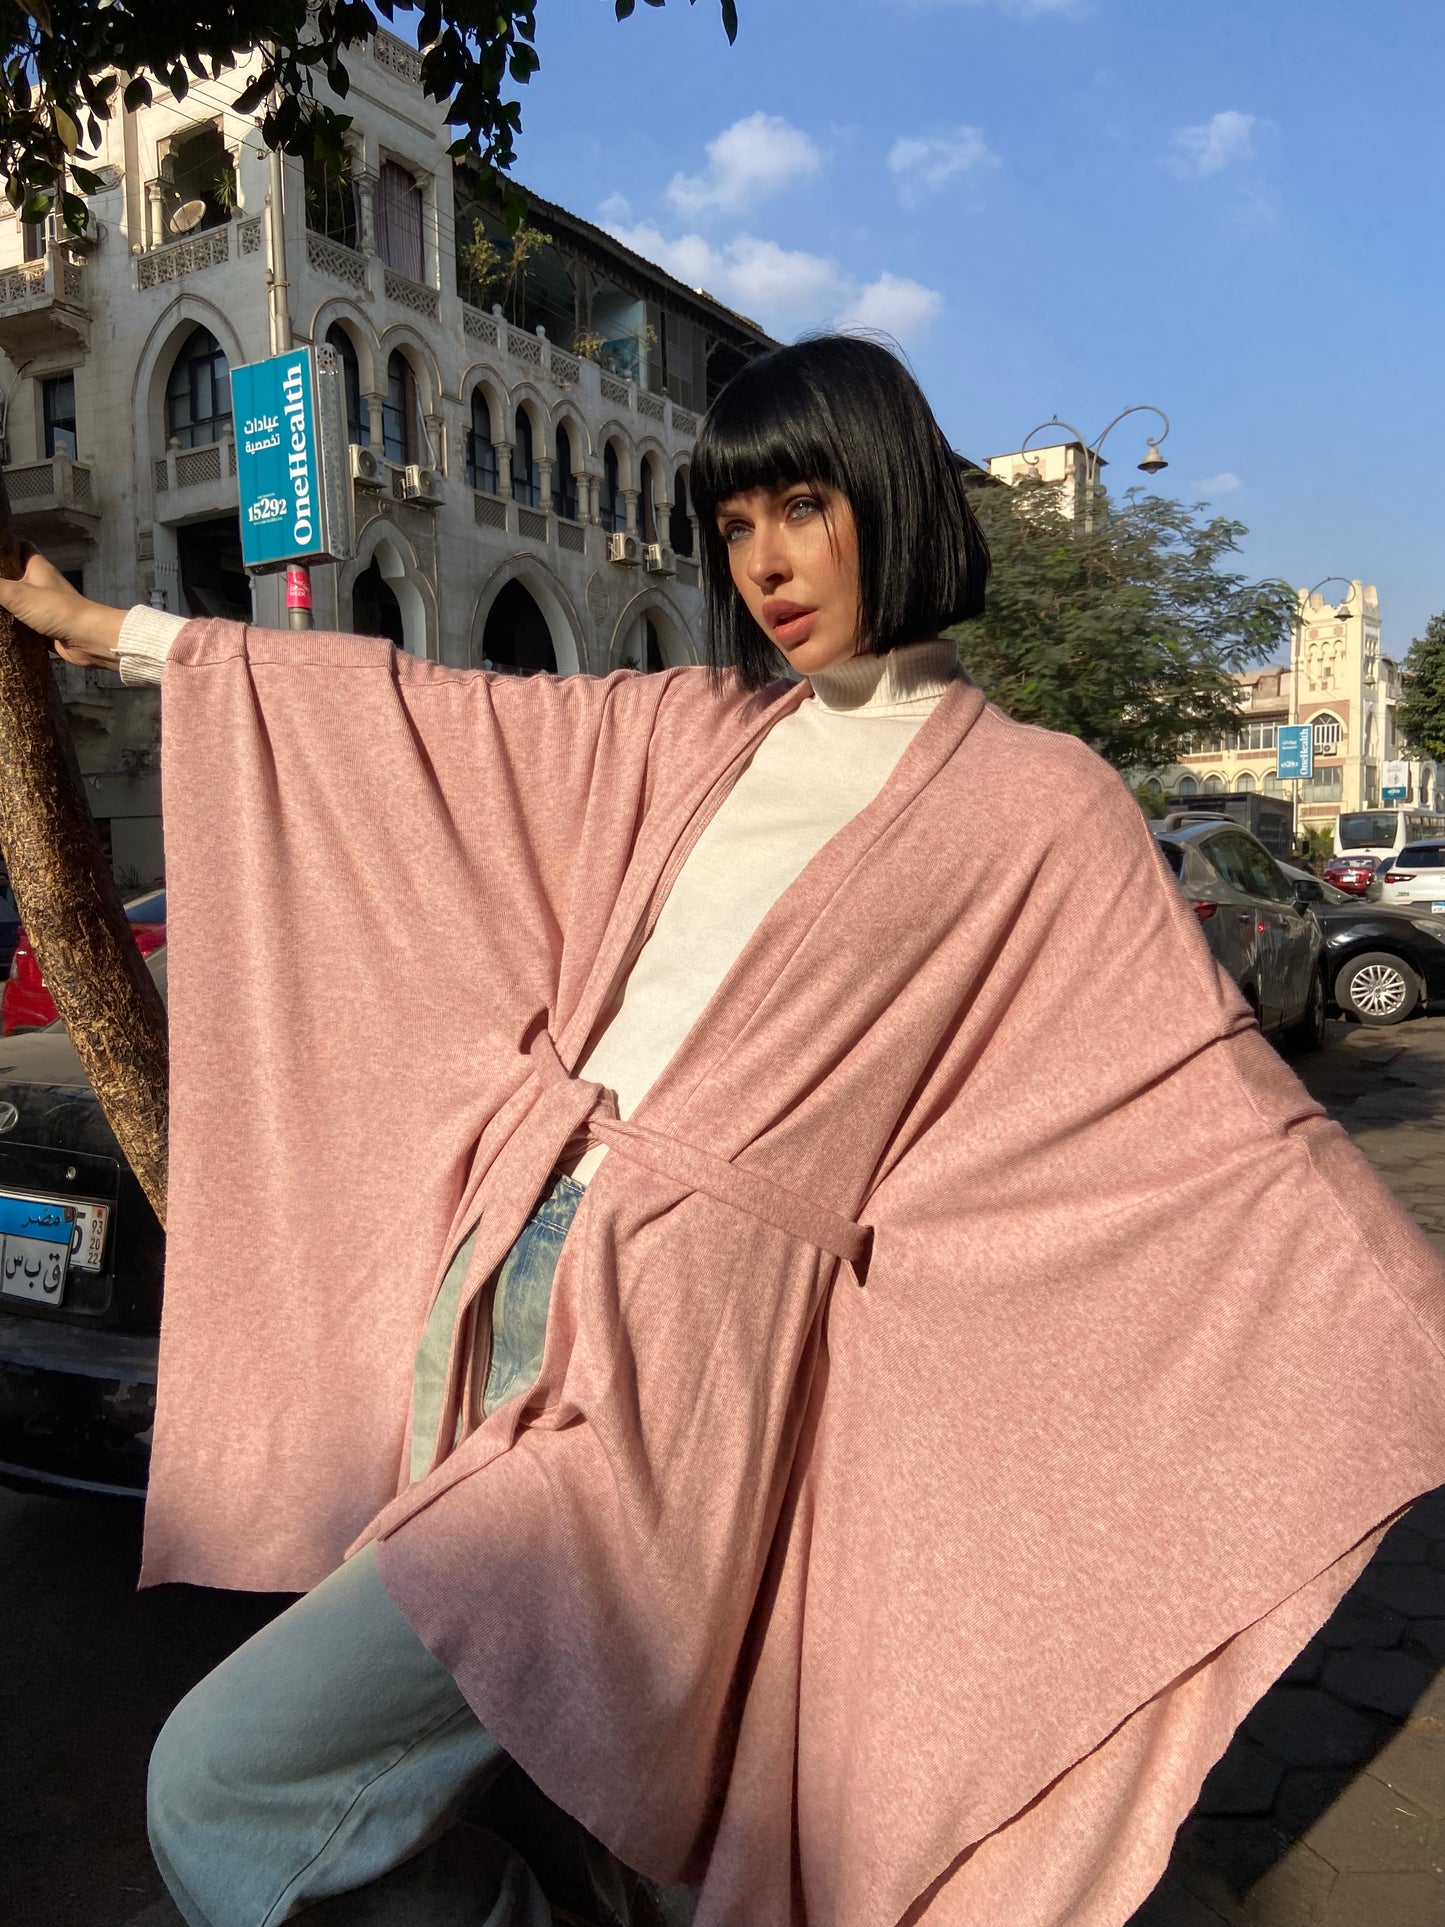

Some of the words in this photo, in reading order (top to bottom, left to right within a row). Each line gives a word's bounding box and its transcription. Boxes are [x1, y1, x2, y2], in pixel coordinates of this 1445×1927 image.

[244, 415, 279, 435] عيادات
[245, 433, 280, 455] تخصصية
[282, 363, 313, 546] OneHealth
[248, 498, 288, 522] 15292
[1299, 728, 1309, 776] OneHealth
[21, 1210, 61, 1228] مصر
